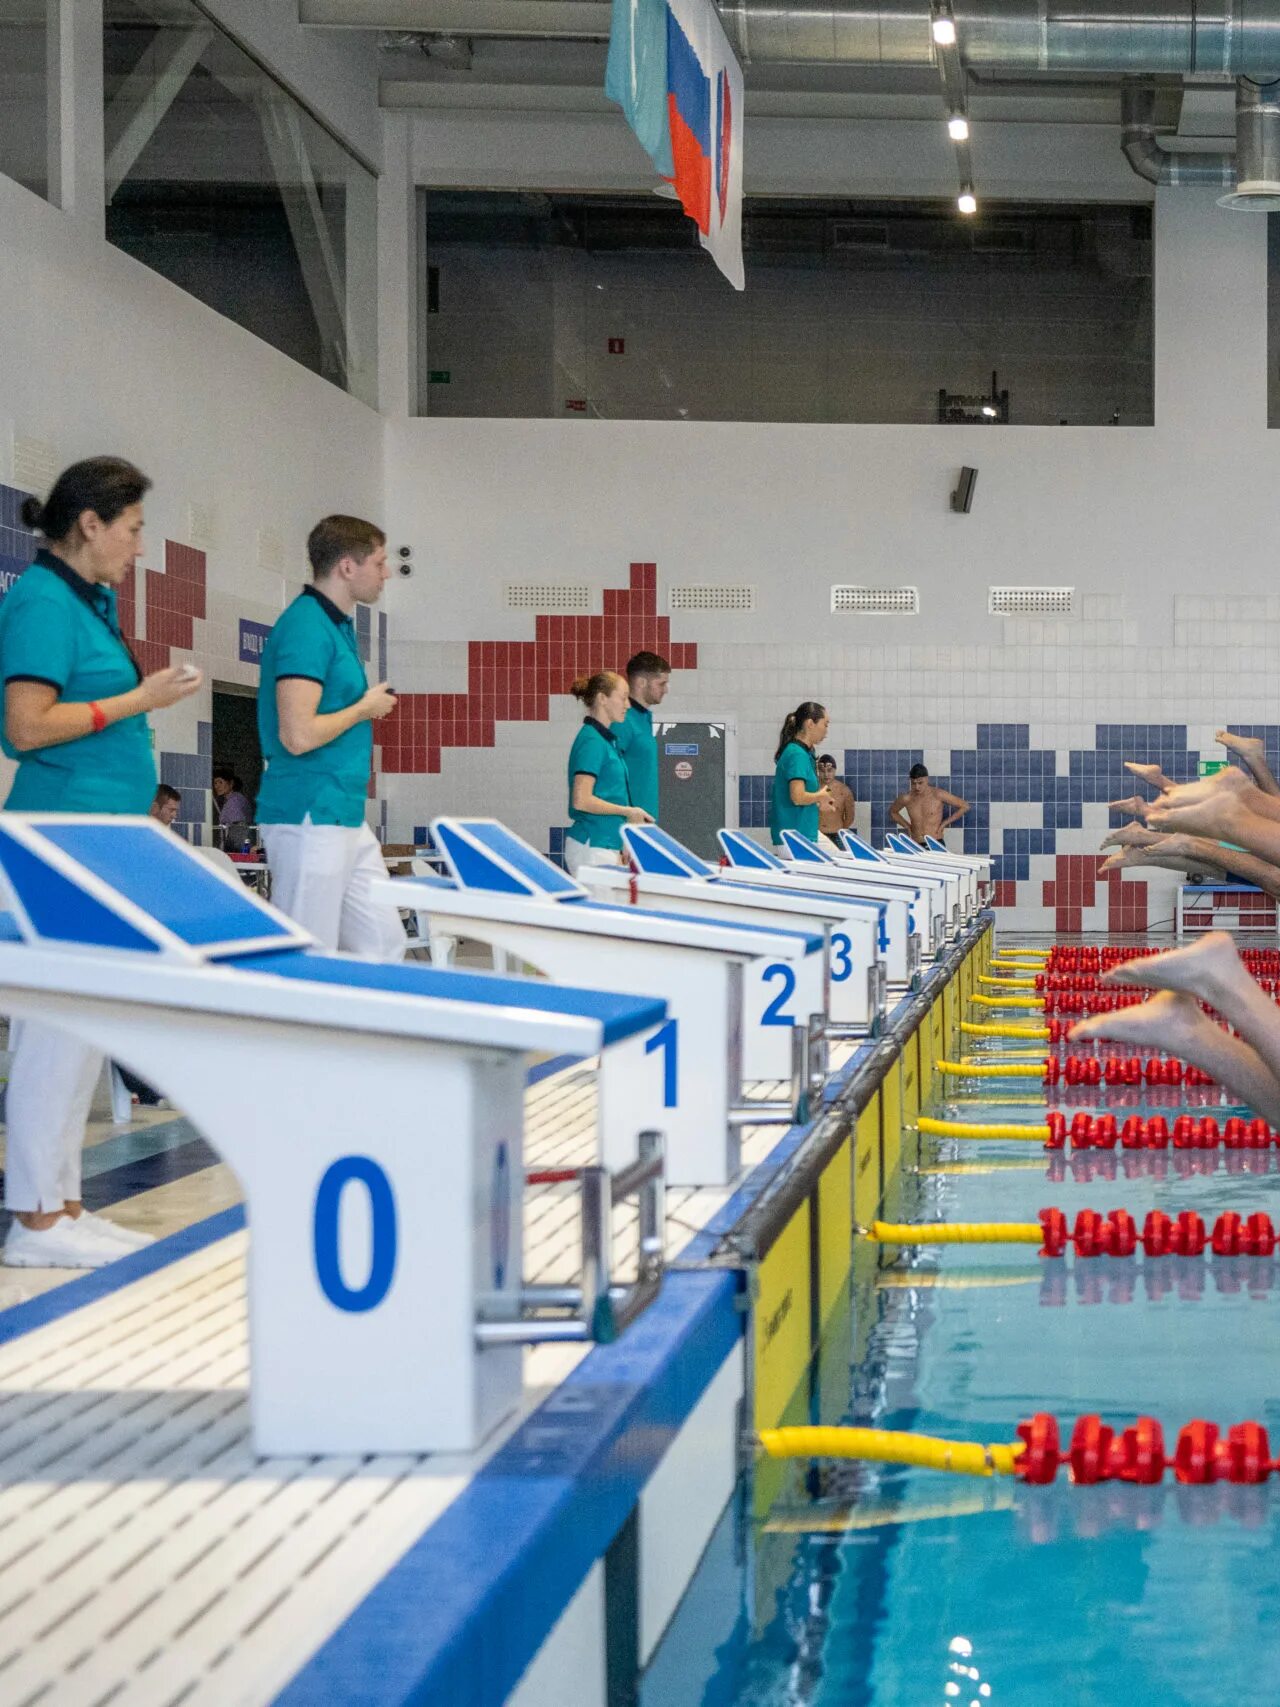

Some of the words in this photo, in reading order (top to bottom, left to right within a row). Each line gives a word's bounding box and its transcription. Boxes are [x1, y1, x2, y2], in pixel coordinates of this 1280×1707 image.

[760, 963, 796, 1026] 2
[831, 933, 853, 982] 3
[645, 1018, 678, 1108] 1
[313, 1154, 397, 1314] 0
